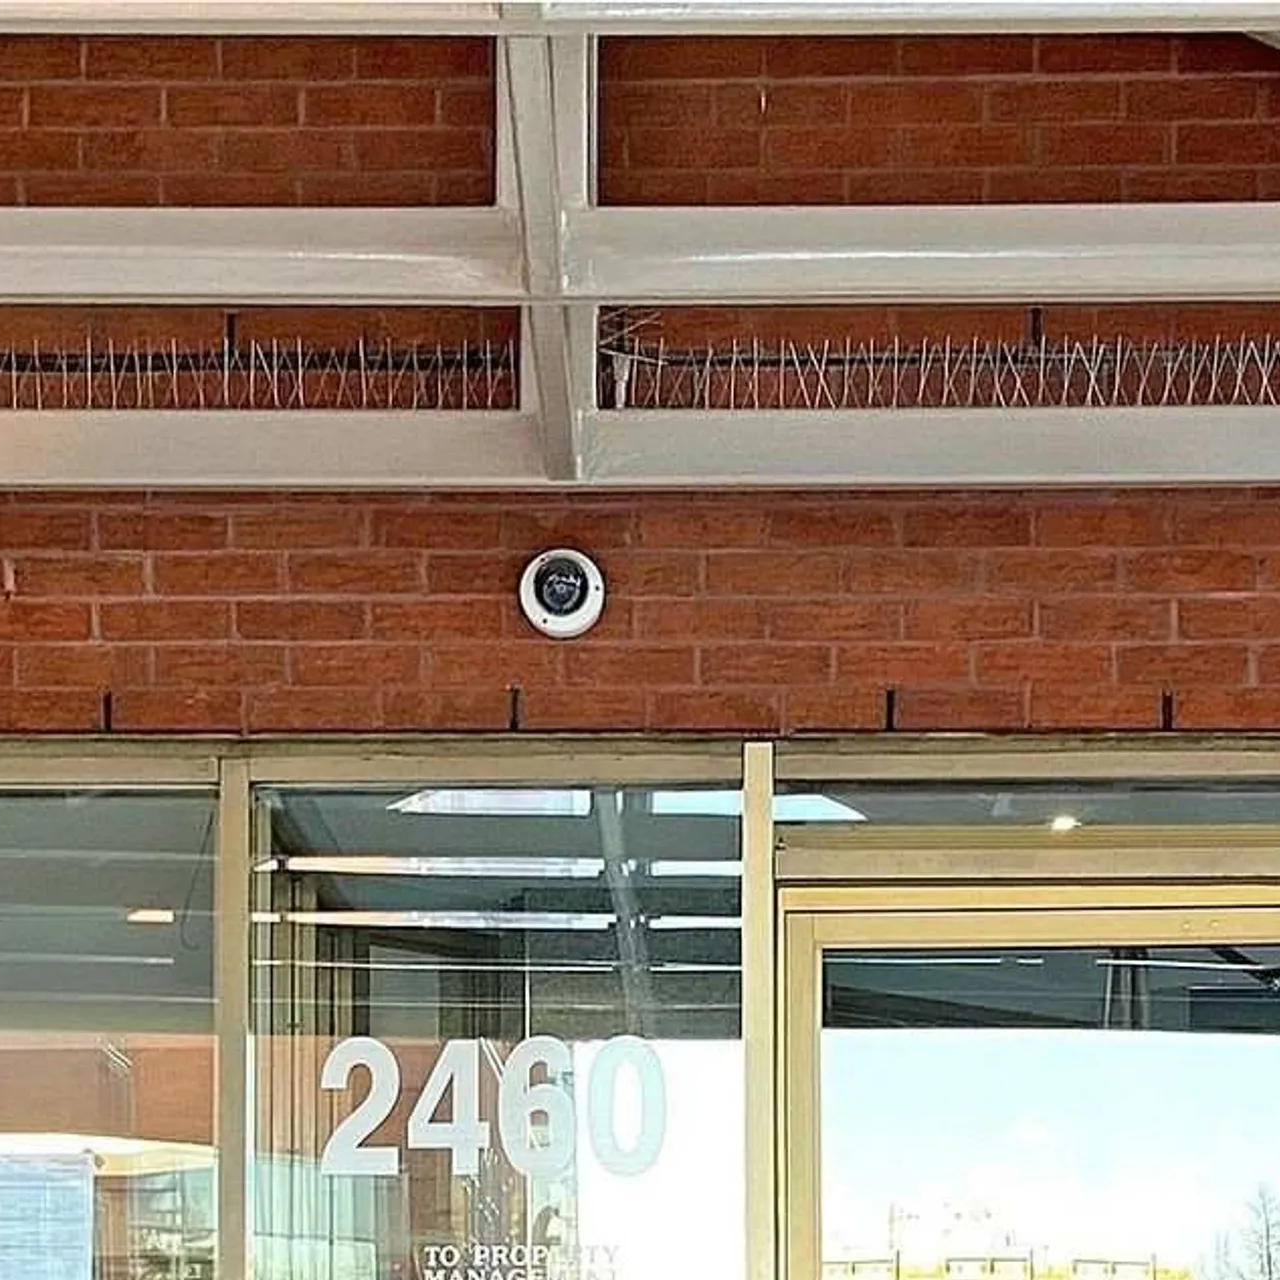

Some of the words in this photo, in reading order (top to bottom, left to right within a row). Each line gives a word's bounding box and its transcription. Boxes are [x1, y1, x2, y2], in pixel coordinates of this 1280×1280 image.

[320, 1035, 667, 1177] 2460
[423, 1245, 461, 1267] TO
[472, 1244, 620, 1267] PROPTY
